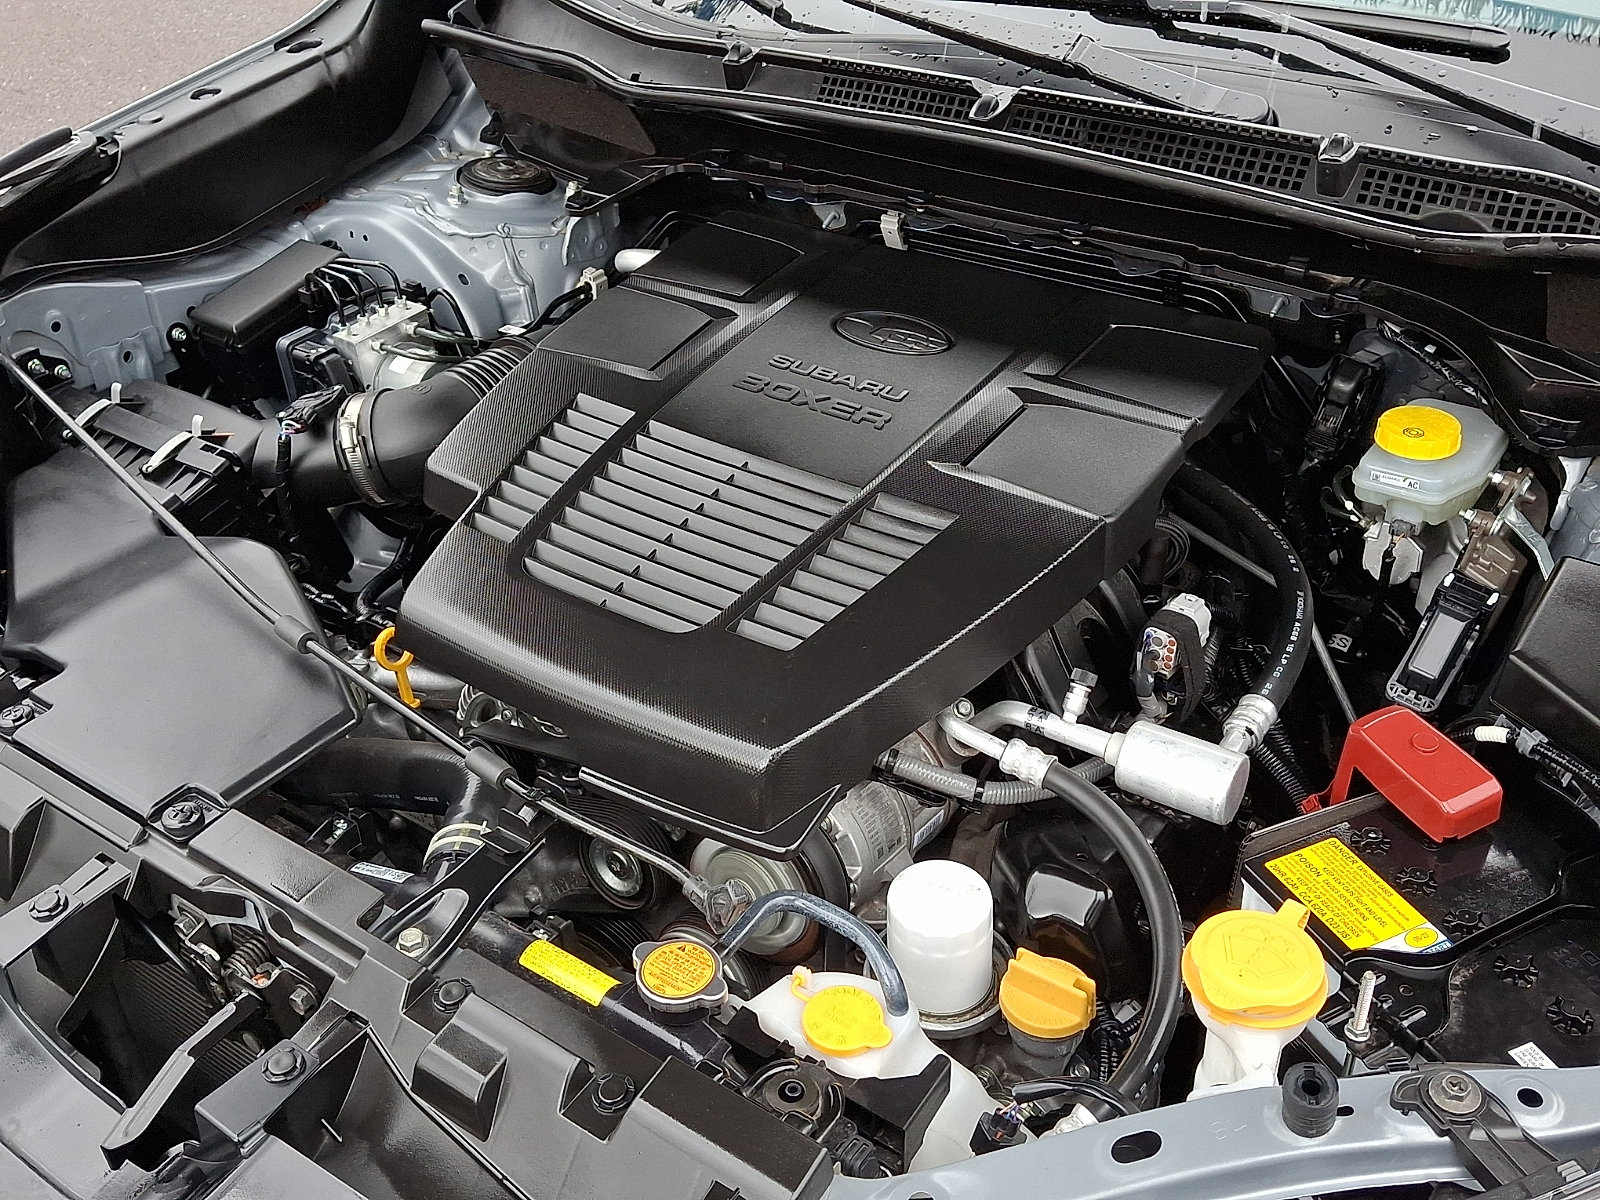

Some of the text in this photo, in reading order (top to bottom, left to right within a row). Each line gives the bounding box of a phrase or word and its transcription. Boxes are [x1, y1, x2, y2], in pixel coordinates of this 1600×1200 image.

[768, 354, 909, 402] SUBARU
[732, 371, 893, 430] BOXER
[1408, 480, 1419, 490] AC
[1281, 653, 1291, 665] LP
[1293, 852, 1323, 877] POISON
[1327, 839, 1358, 865] DANGER
[1297, 890, 1315, 904] CCA
